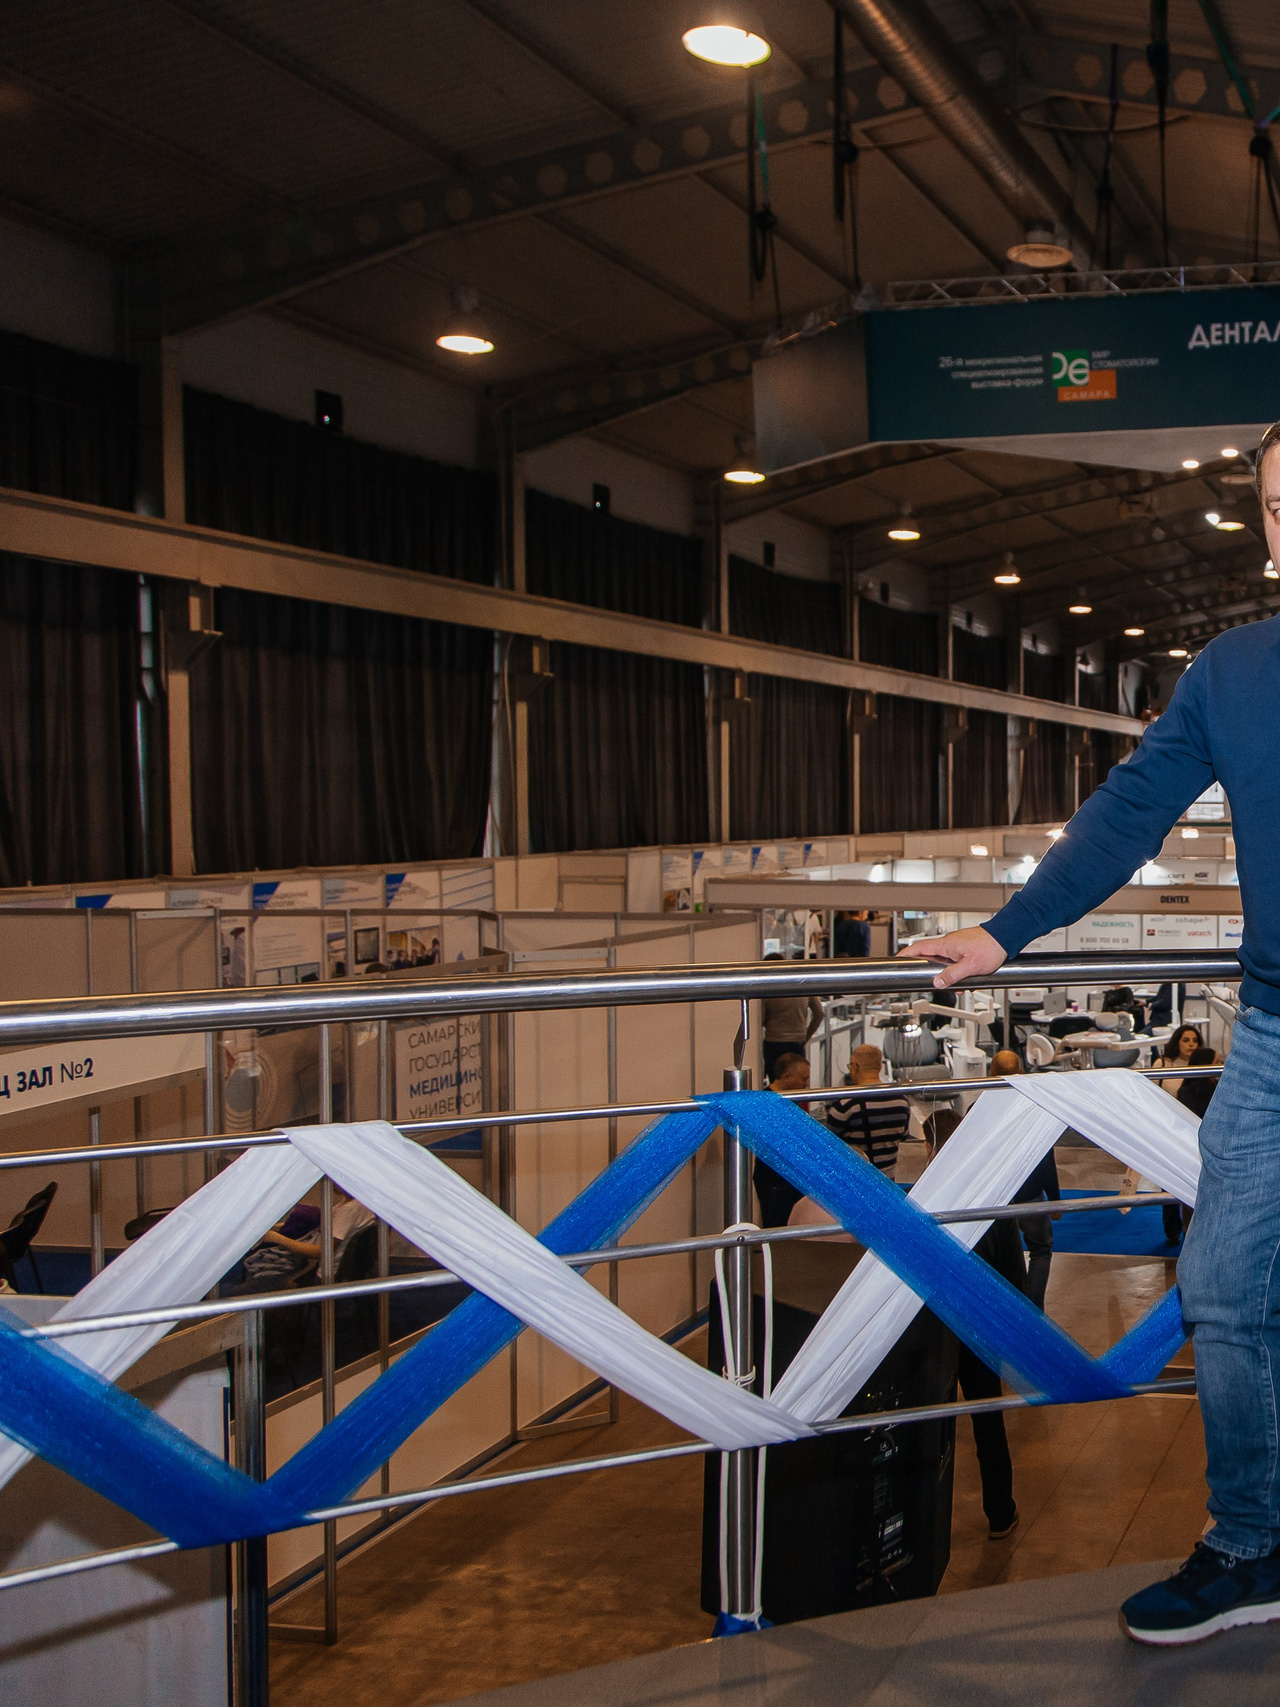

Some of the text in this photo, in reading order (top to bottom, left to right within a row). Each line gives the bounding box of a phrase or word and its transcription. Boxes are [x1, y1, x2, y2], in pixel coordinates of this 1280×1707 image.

[1160, 895, 1190, 904] DENTEX
[17, 1066, 53, 1093] ЗАЛ
[60, 1057, 94, 1083] №2
